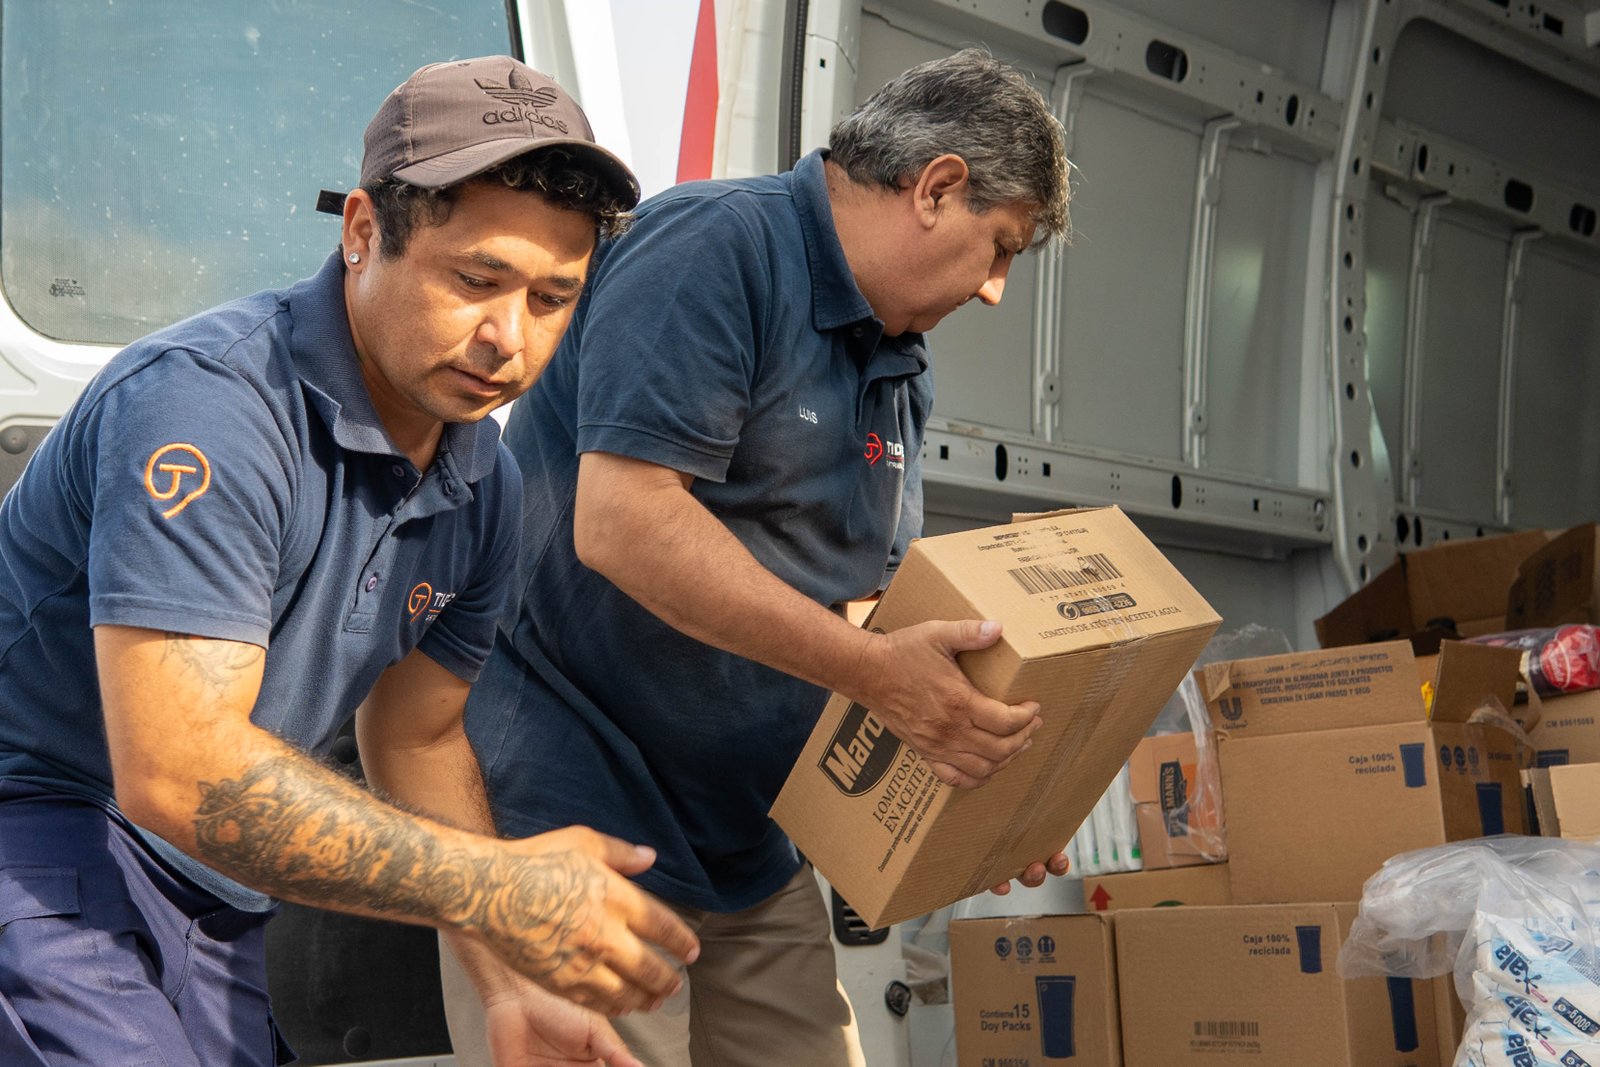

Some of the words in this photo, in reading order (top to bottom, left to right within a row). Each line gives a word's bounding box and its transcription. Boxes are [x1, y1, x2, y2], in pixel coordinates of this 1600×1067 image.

[483, 106, 568, 138] adidas
[799, 405, 818, 424] LUIS
[1038, 626, 1080, 639] LOMITOS
[1075, 623, 1091, 631] DE
[1156, 606, 1182, 615] AGUA
[1348, 755, 1368, 765] Caja
[1371, 752, 1394, 762] 100%
[1355, 764, 1396, 774] reciclada
[872, 760, 912, 823] LOMITOS
[905, 749, 918, 765] D
[884, 810, 900, 834] EN
[897, 763, 927, 815] ACEITE
[1243, 935, 1263, 945] Caja
[1266, 934, 1290, 943] 100%
[1249, 947, 1291, 955] reciclada
[981, 1021, 1000, 1033] Doy
[1002, 1021, 1031, 1031] Packs
